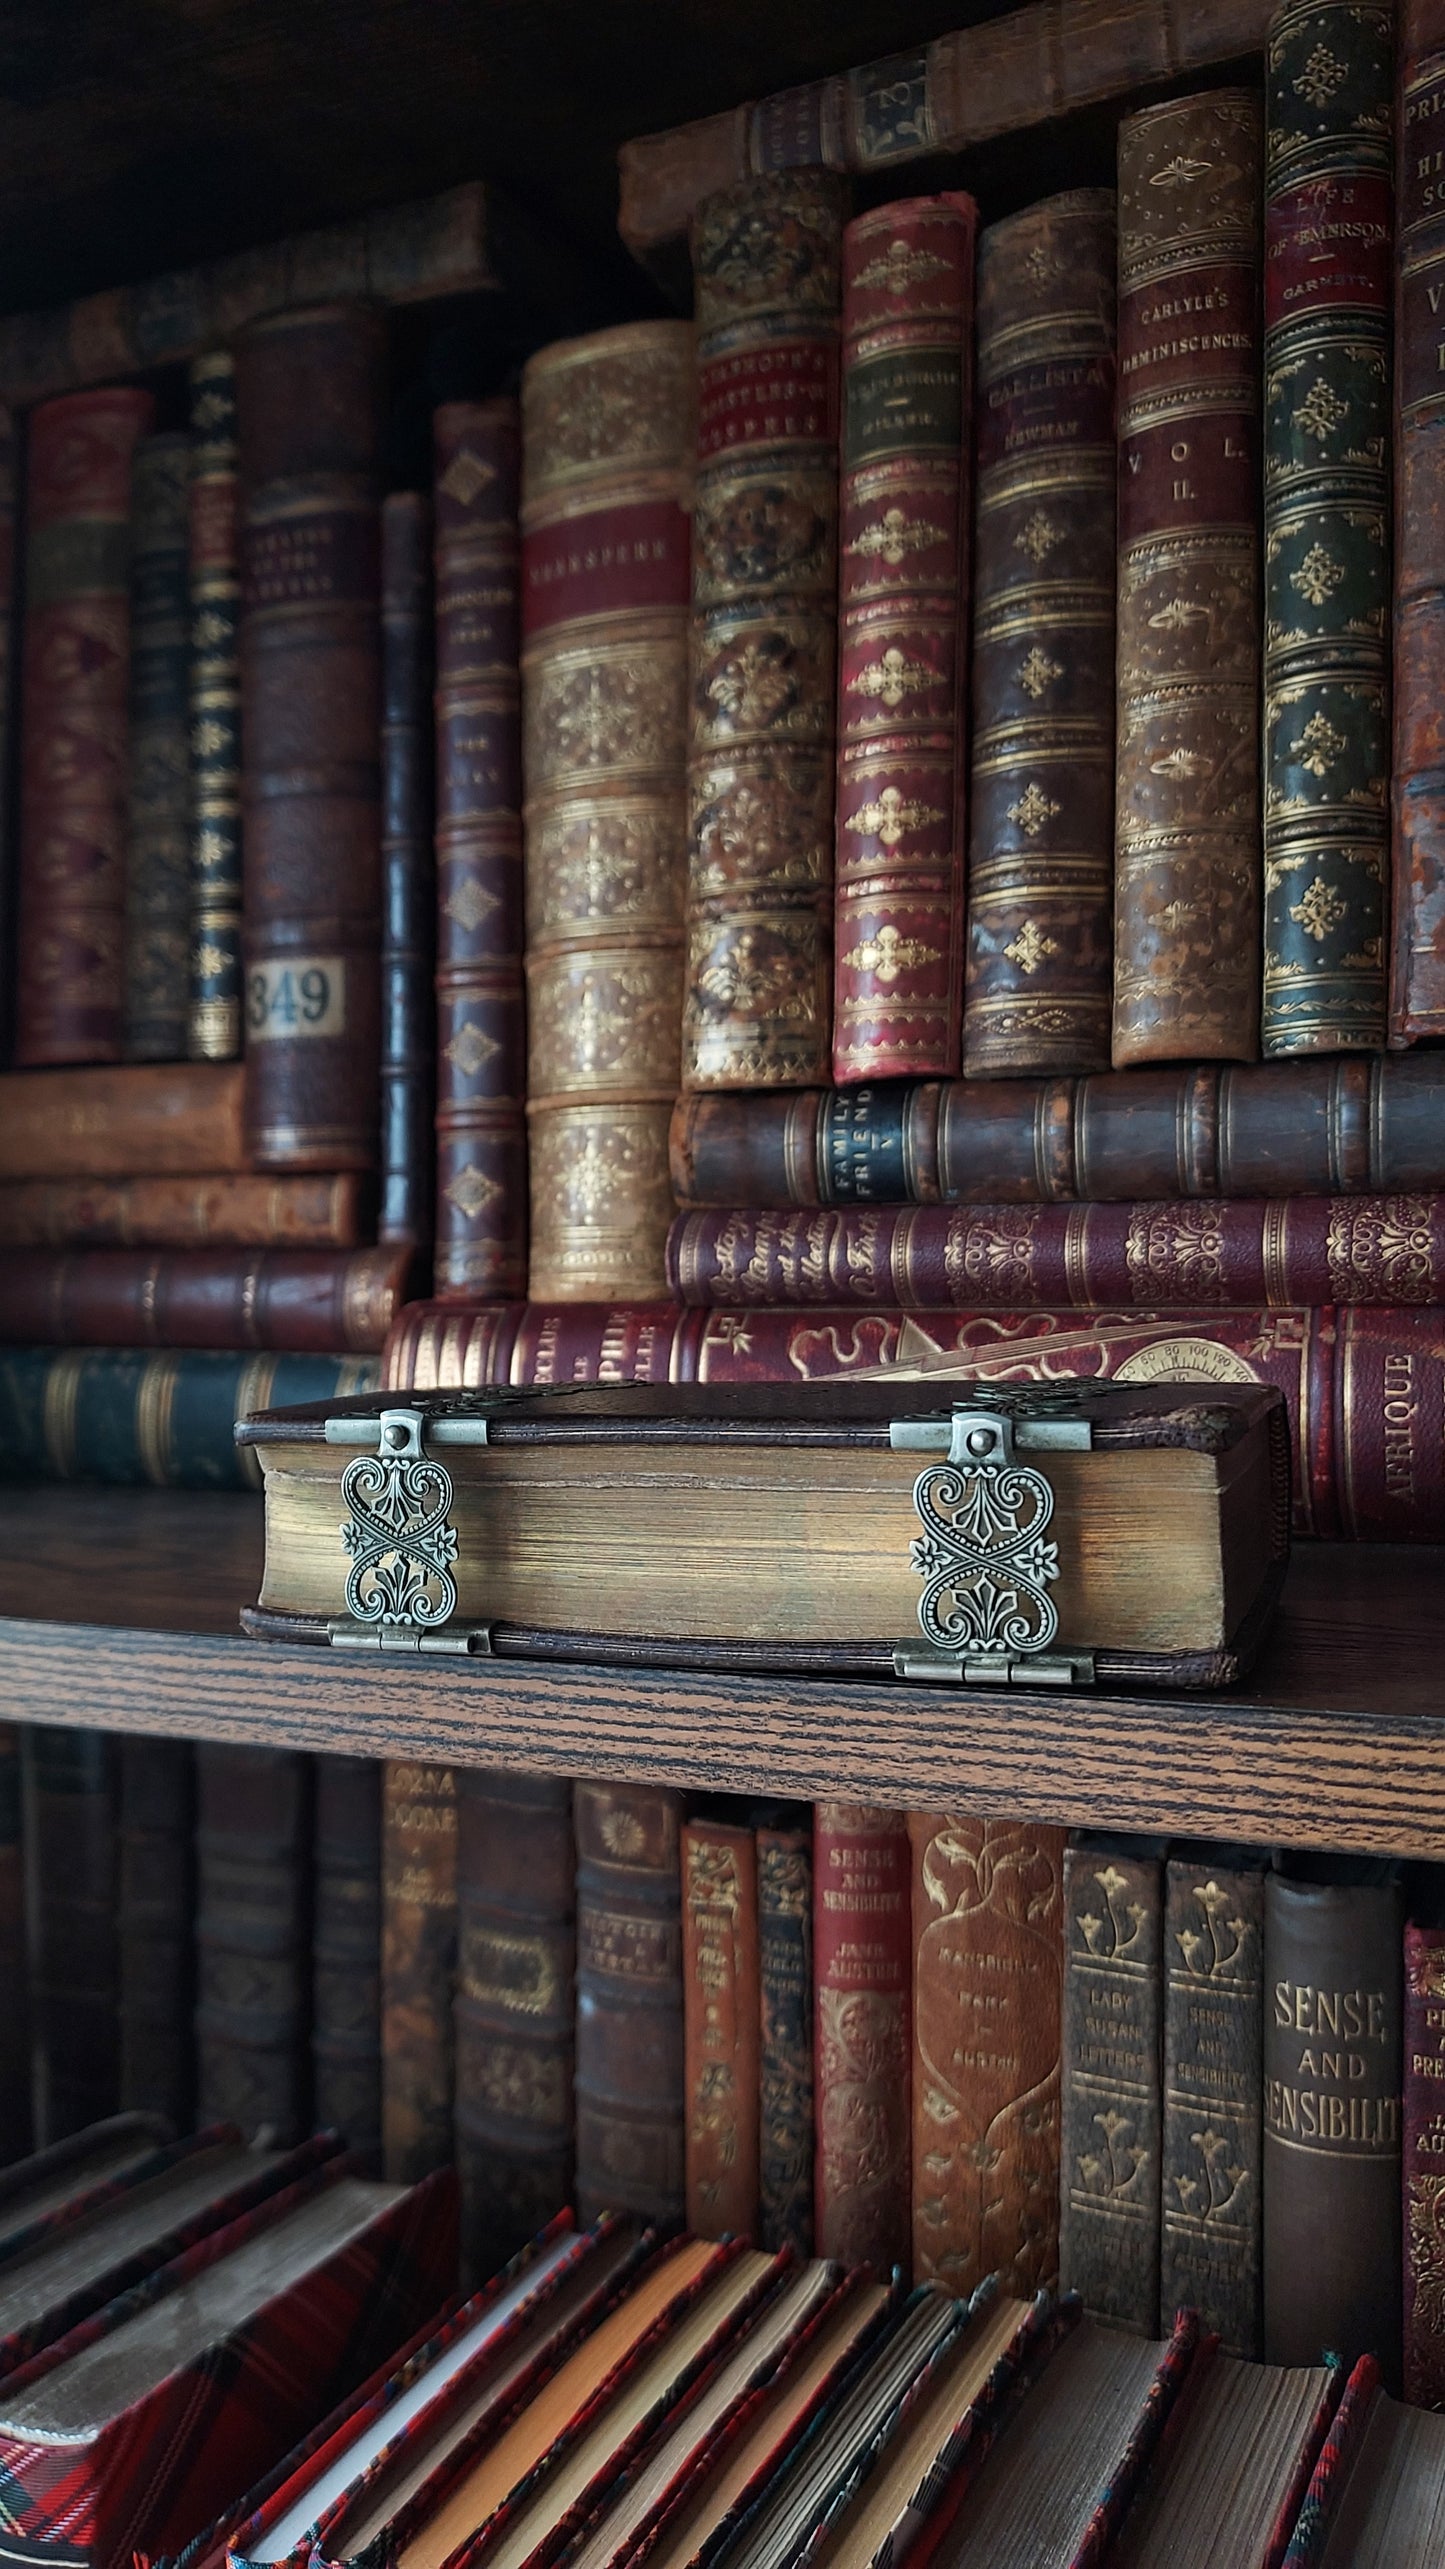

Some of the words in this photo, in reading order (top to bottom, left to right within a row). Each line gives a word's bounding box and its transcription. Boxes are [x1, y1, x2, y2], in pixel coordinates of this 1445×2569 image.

[1269, 239, 1287, 259] OF
[1141, 287, 1229, 326] CARLYLE'S
[246, 968, 331, 1030] 349
[833, 1096, 850, 1188] FAMILY
[853, 1089, 873, 1196] FRIEND
[1165, 1345, 1180, 1356] 80
[1189, 1345, 1209, 1357] 100
[1213, 1351, 1232, 1368] 120
[1383, 1354, 1419, 1503] AFRIQUE
[829, 1848, 895, 1868] SENSE
[841, 1873, 879, 1889] AND
[1089, 1988, 1134, 2010] LADY
[1274, 1979, 1387, 2044] SENSE
[1298, 2049, 1366, 2080] AND
